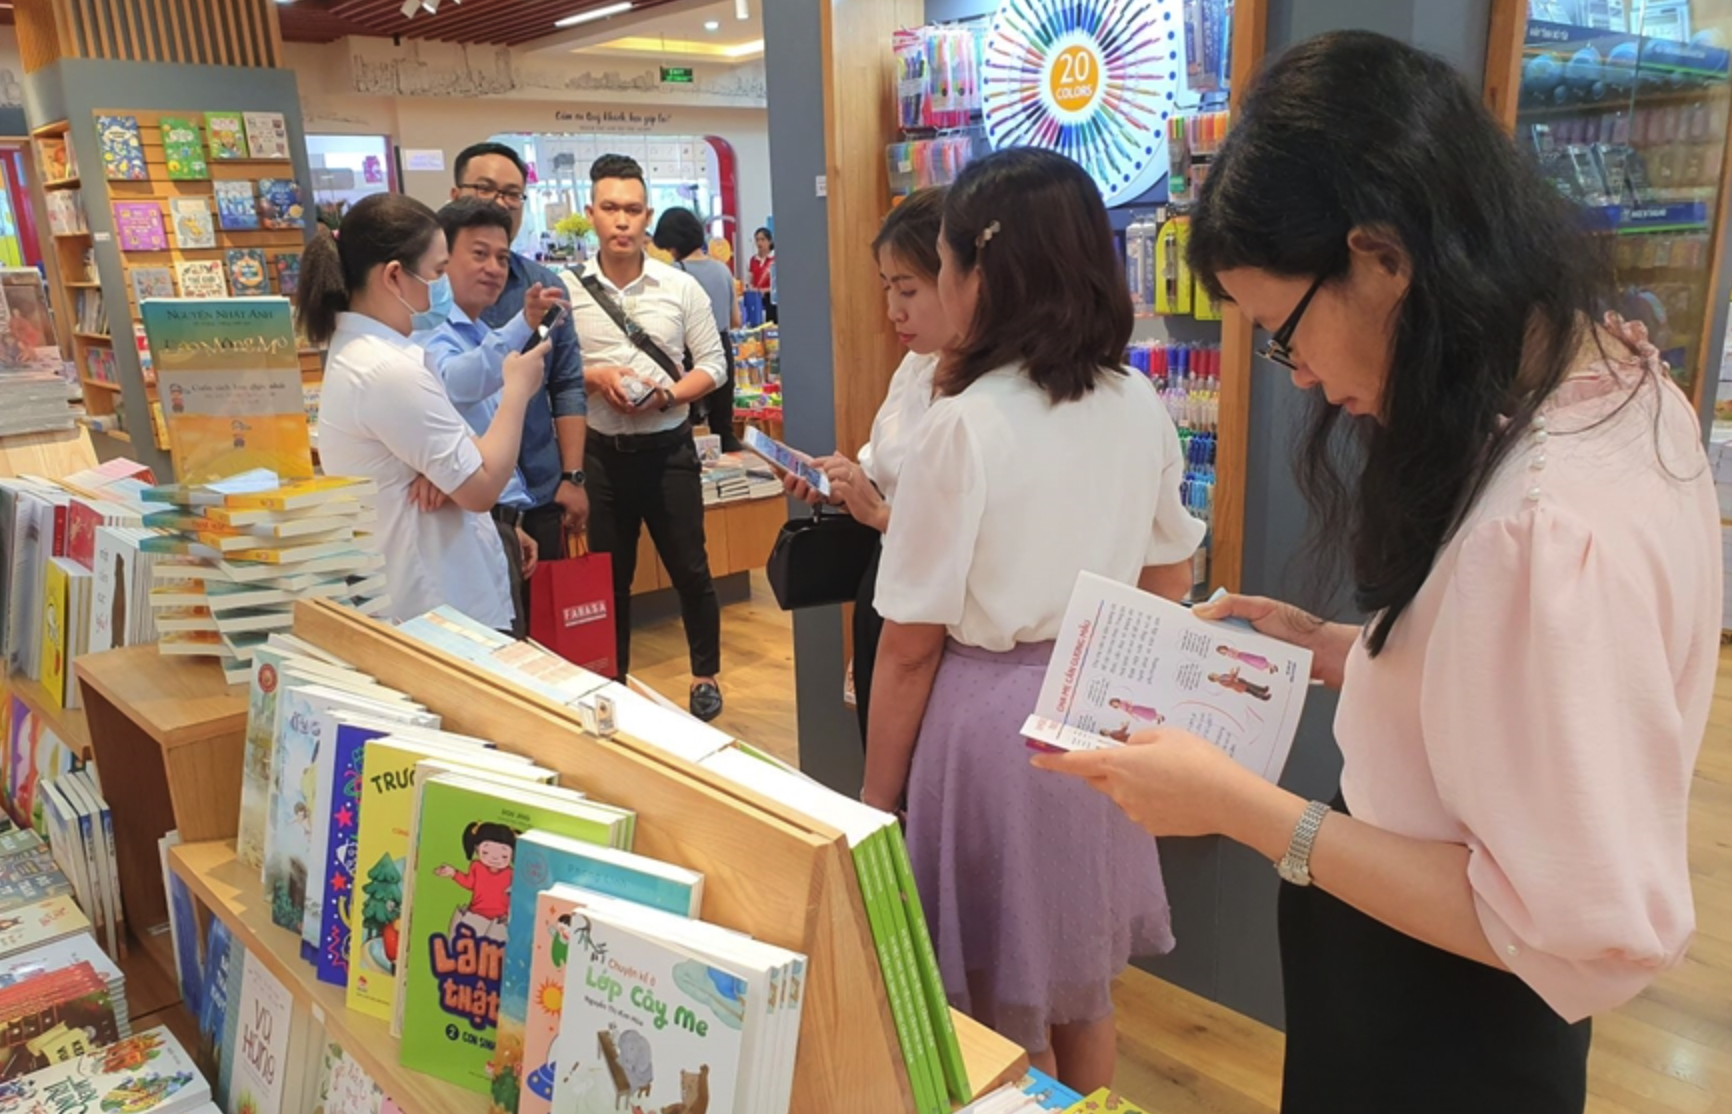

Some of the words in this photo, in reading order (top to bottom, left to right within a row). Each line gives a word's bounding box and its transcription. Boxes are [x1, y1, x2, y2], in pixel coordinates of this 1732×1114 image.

[1059, 51, 1089, 84] 20
[1056, 84, 1093, 100] COLORS
[563, 600, 607, 621] FAHASA
[585, 964, 623, 1003] Lớp
[629, 985, 669, 1031] Cây
[673, 1004, 709, 1038] Me
